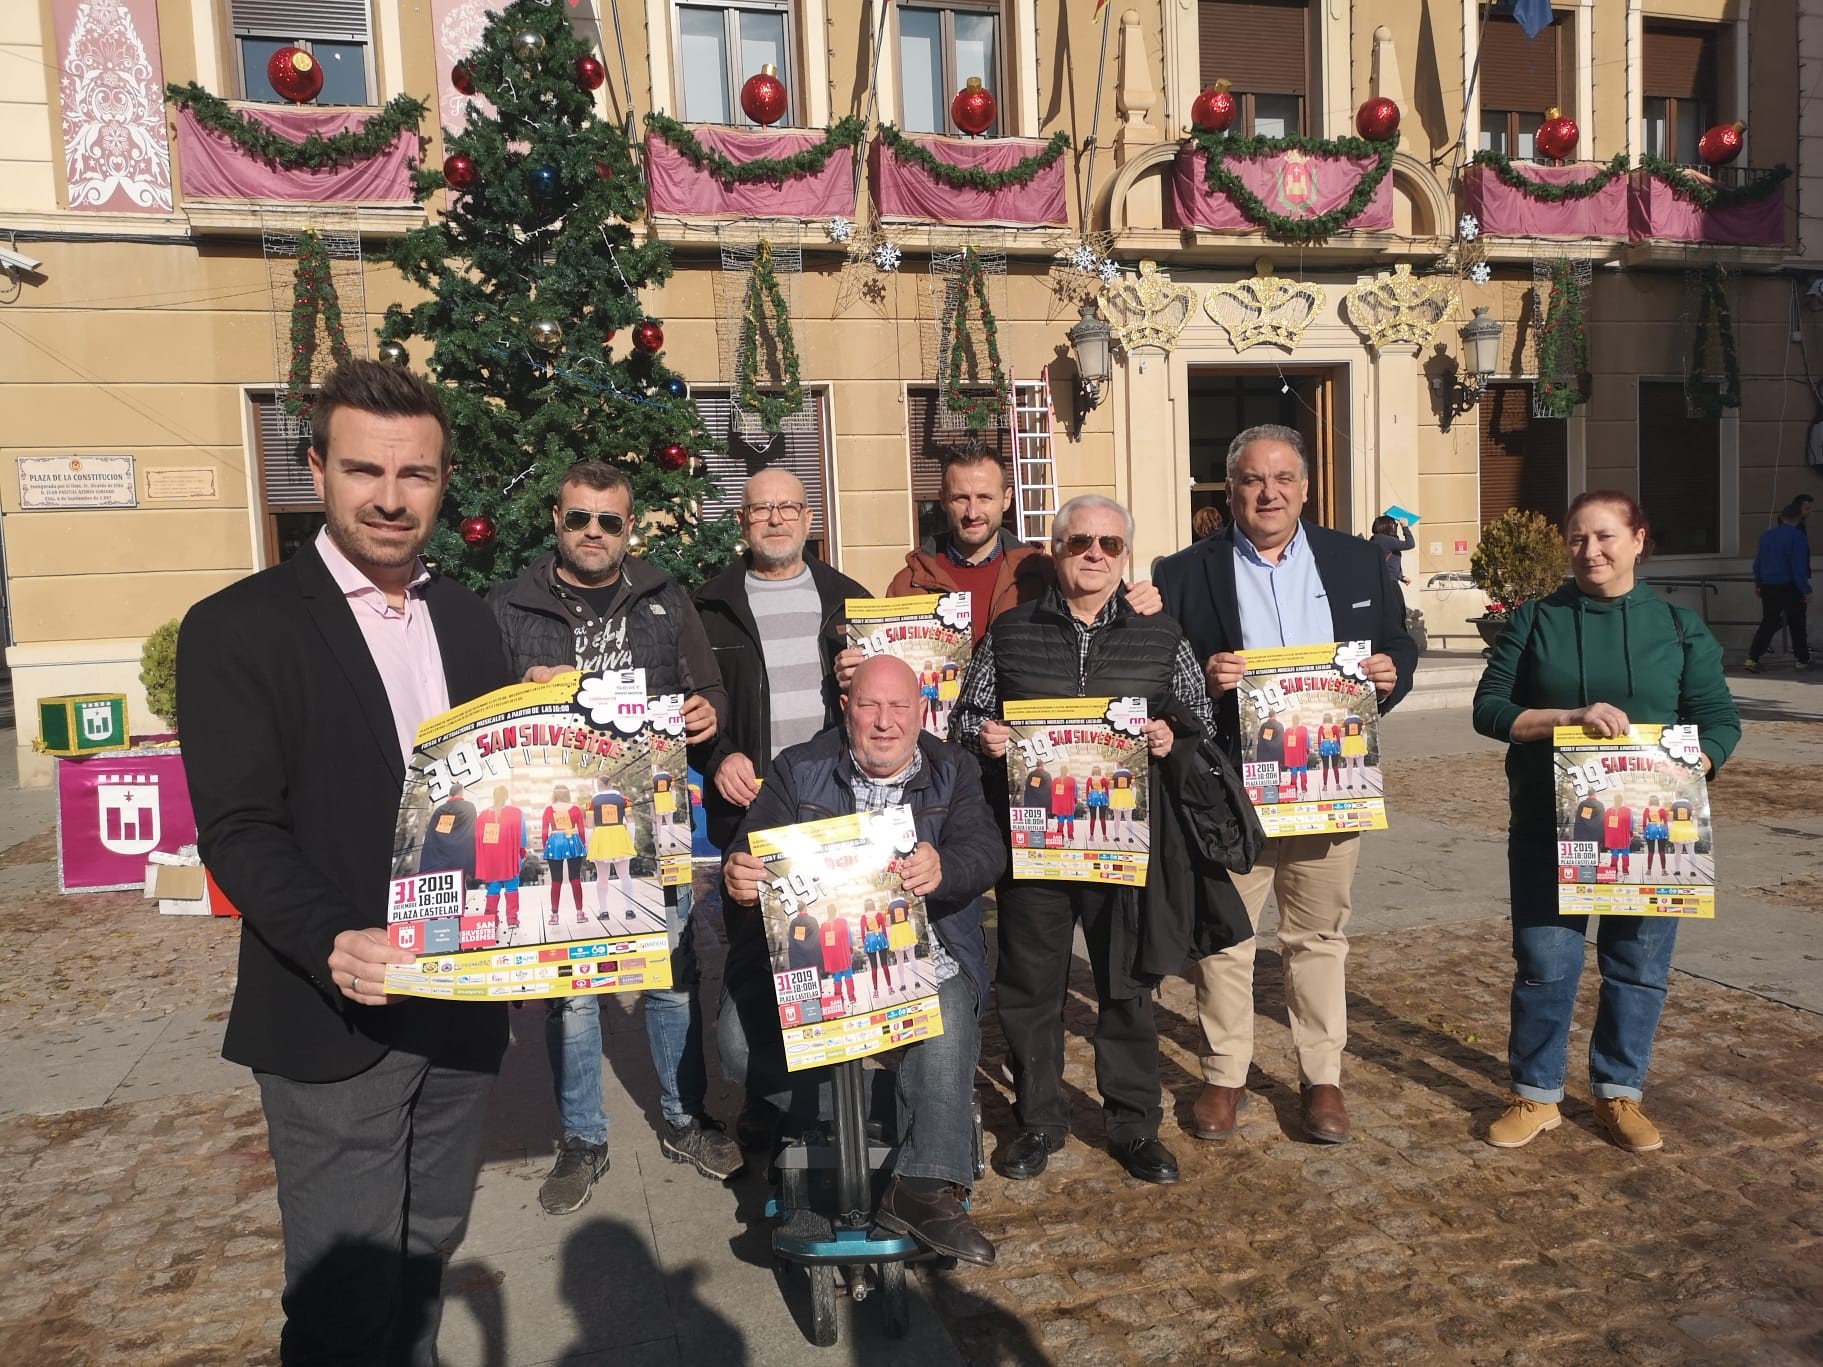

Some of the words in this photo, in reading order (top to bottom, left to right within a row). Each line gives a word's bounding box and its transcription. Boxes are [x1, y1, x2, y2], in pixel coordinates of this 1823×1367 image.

[886, 626, 906, 643] SAN
[1280, 677, 1304, 696] SAN
[1250, 683, 1287, 720] 39
[476, 714, 505, 728] MUSICALES
[512, 708, 532, 718] PARTIR
[542, 705, 552, 713] LAS
[476, 726, 517, 758] SAN
[519, 724, 624, 760] SILVESTRE
[1048, 730, 1072, 747] SAN
[1018, 734, 1054, 768] 39
[423, 742, 484, 803] 39
[1245, 765, 1256, 778] 31
[1256, 764, 1274, 772] 2019
[1602, 756, 1628, 774] SAN
[1567, 761, 1608, 798] 39
[1012, 810, 1023, 822] 31
[1024, 810, 1042, 818] 2019
[1560, 842, 1572, 856] 31
[1574, 843, 1593, 852] 2019
[394, 880, 416, 904] 31
[418, 874, 454, 894] 2019
[772, 872, 818, 916] 39
[418, 891, 458, 906] 18:00H
[392, 910, 418, 920] PLAZA
[420, 905, 459, 918] CASTELAR
[461, 928, 496, 937] SILVESTRE
[476, 921, 496, 930] SAN
[461, 934, 496, 942] ELDENSE
[777, 974, 792, 992] 31
[790, 970, 813, 984] 2019
[792, 981, 818, 994] 18:00H
[780, 994, 795, 1003] PLAZA
[795, 990, 818, 1000] CASTELAR
